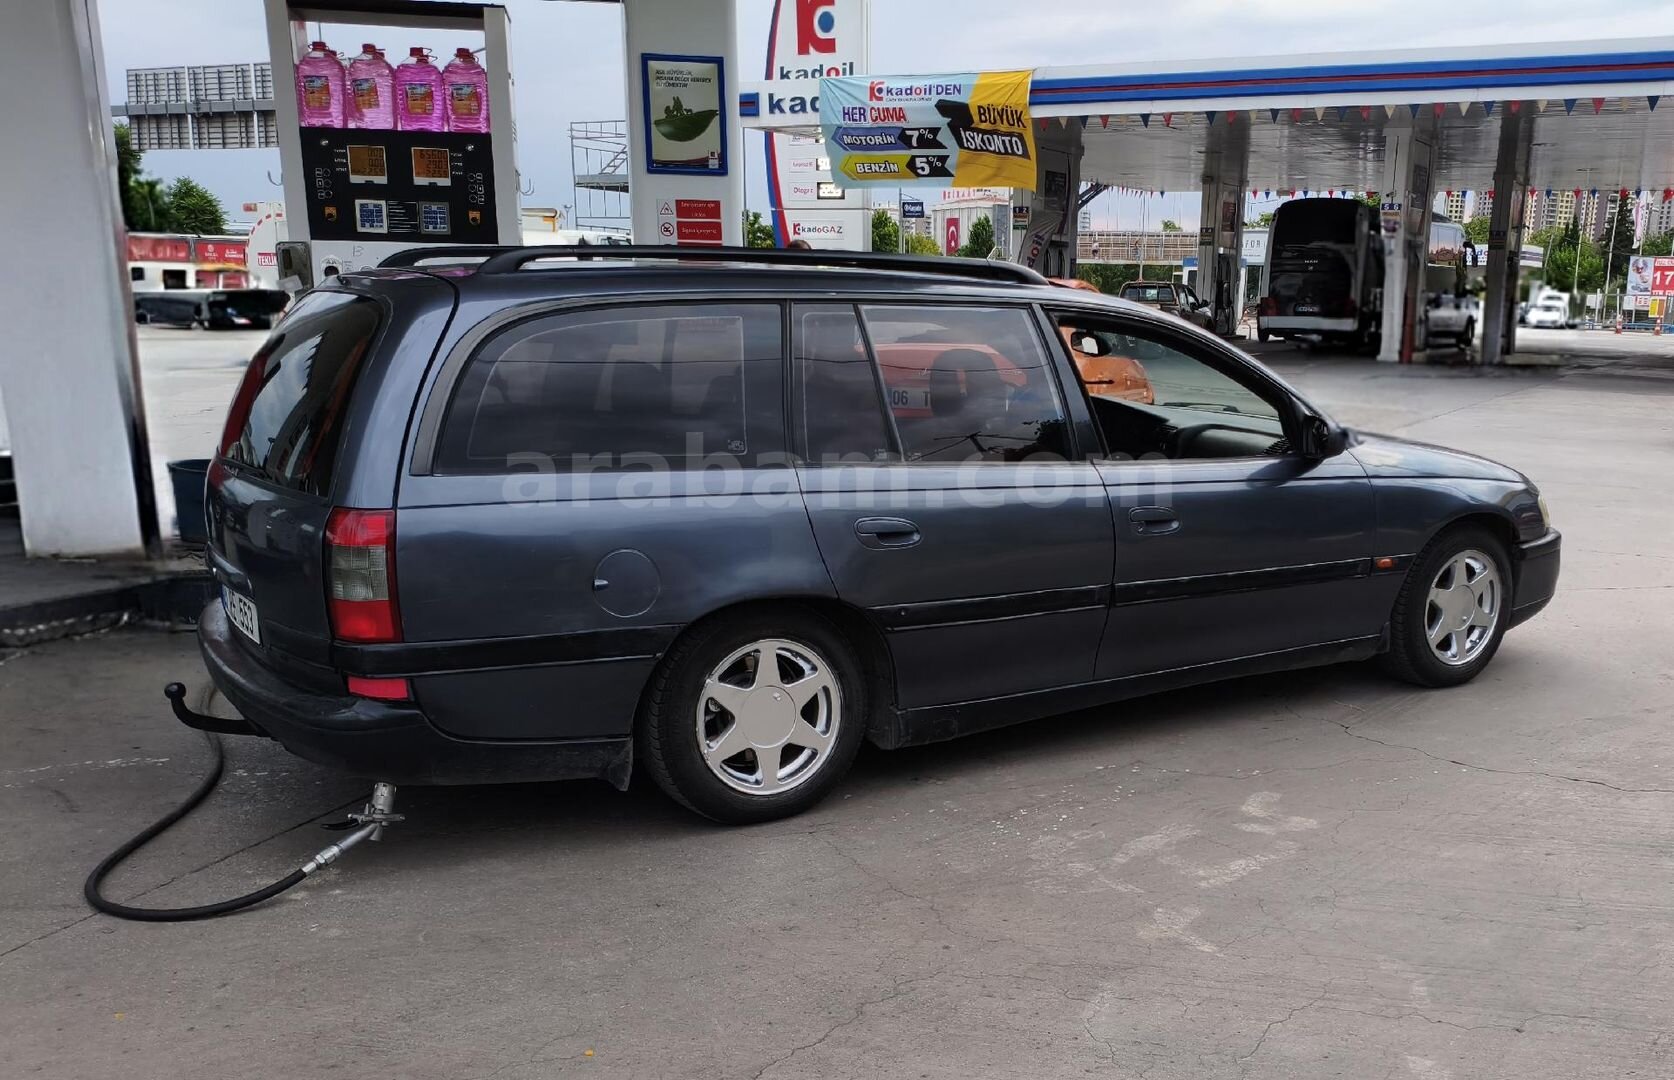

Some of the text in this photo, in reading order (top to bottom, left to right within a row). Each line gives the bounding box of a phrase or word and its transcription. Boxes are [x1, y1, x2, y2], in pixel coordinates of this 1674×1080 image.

[779, 62, 854, 80] kadoil
[842, 106, 907, 123] HER CUMA
[977, 104, 1027, 129] BÜYÜK
[842, 132, 896, 146] MOTORİN
[960, 128, 1022, 155] İSKONTO
[855, 160, 899, 174] BENZİN
[892, 390, 908, 406] 06
